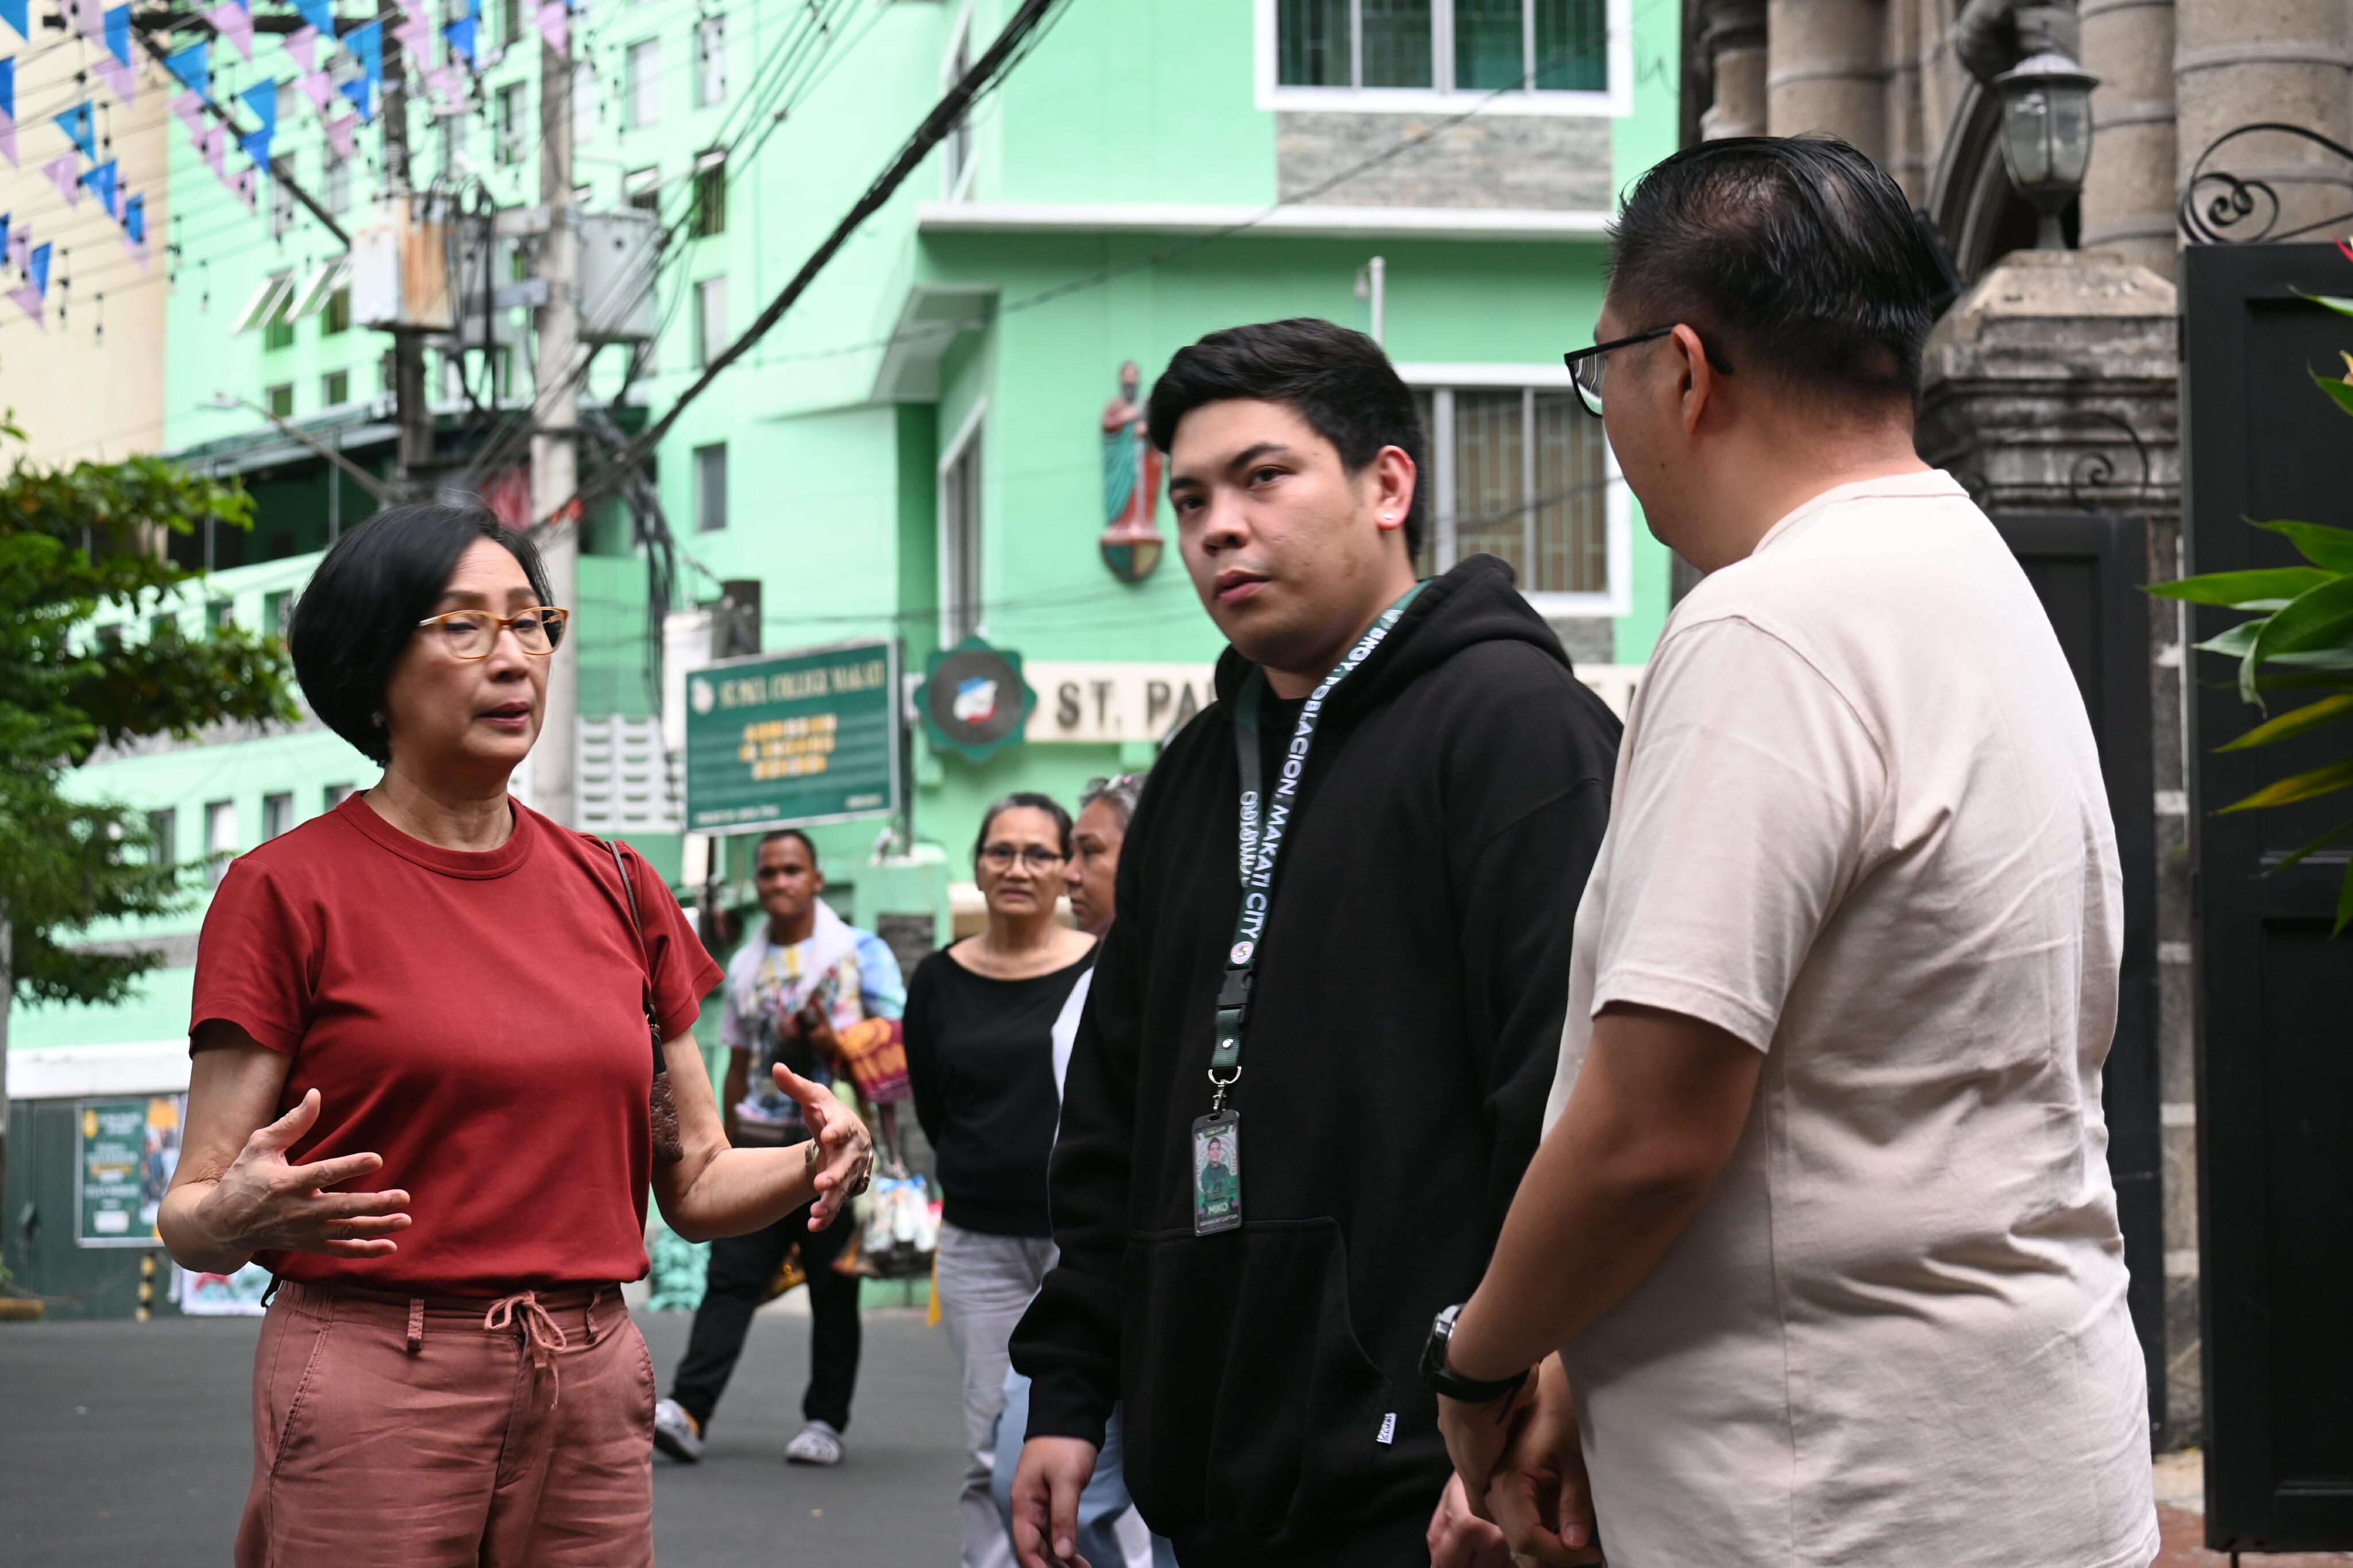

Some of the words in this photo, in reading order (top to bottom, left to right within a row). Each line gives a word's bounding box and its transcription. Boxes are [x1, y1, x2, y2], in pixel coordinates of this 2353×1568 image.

[1057, 680, 1121, 731] ST.
[1147, 680, 1217, 729] PA
[1251, 804, 1290, 887] MAKATI
[1240, 893, 1268, 939] CITY
